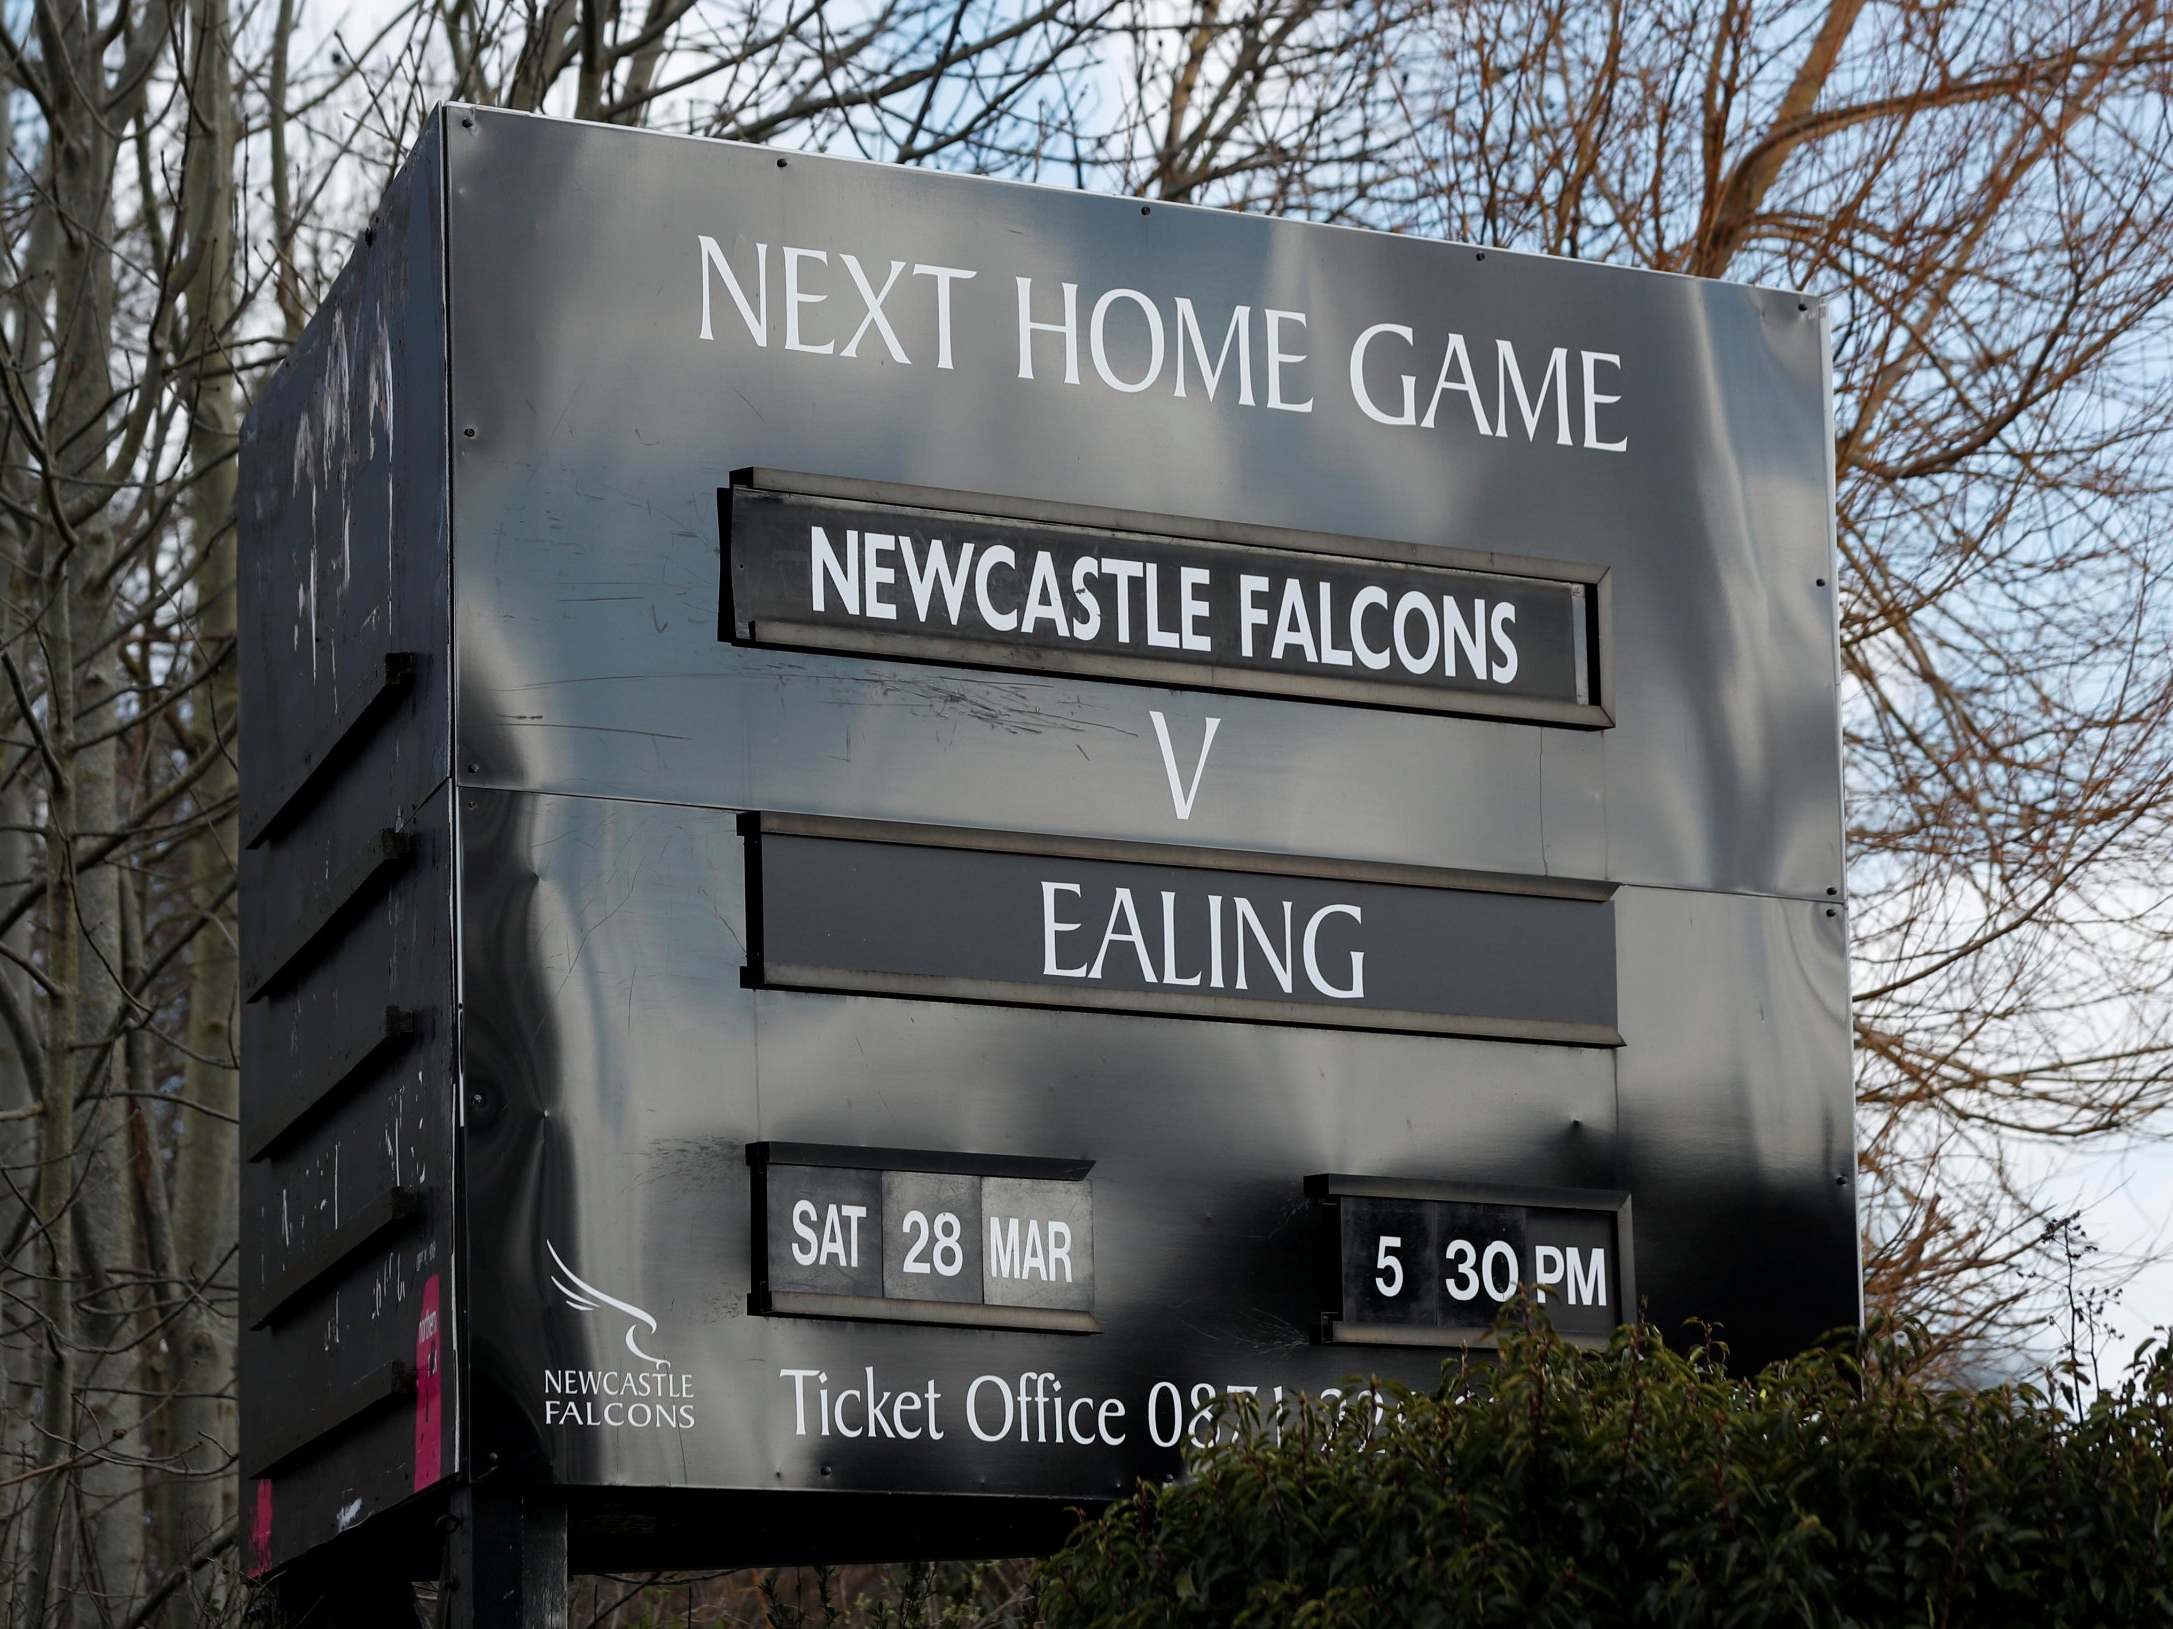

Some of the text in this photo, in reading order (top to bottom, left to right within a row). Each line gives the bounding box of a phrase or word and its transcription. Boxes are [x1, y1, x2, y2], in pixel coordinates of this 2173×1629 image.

[698, 235, 1627, 451] NEXT HOME GAME
[812, 526, 1517, 683] NEWCASTLE FALCONS
[1150, 711, 1220, 820] V
[1041, 882, 1364, 998] EALING
[792, 1200, 1072, 1282] SAT 28 MAR
[1375, 1235, 1607, 1306] 5 30 PM
[544, 1370, 695, 1399] NEWCASTLE
[545, 1401, 695, 1429] FALCONS
[780, 1366, 944, 1439] Ticket
[966, 1372, 1126, 1446] Office
